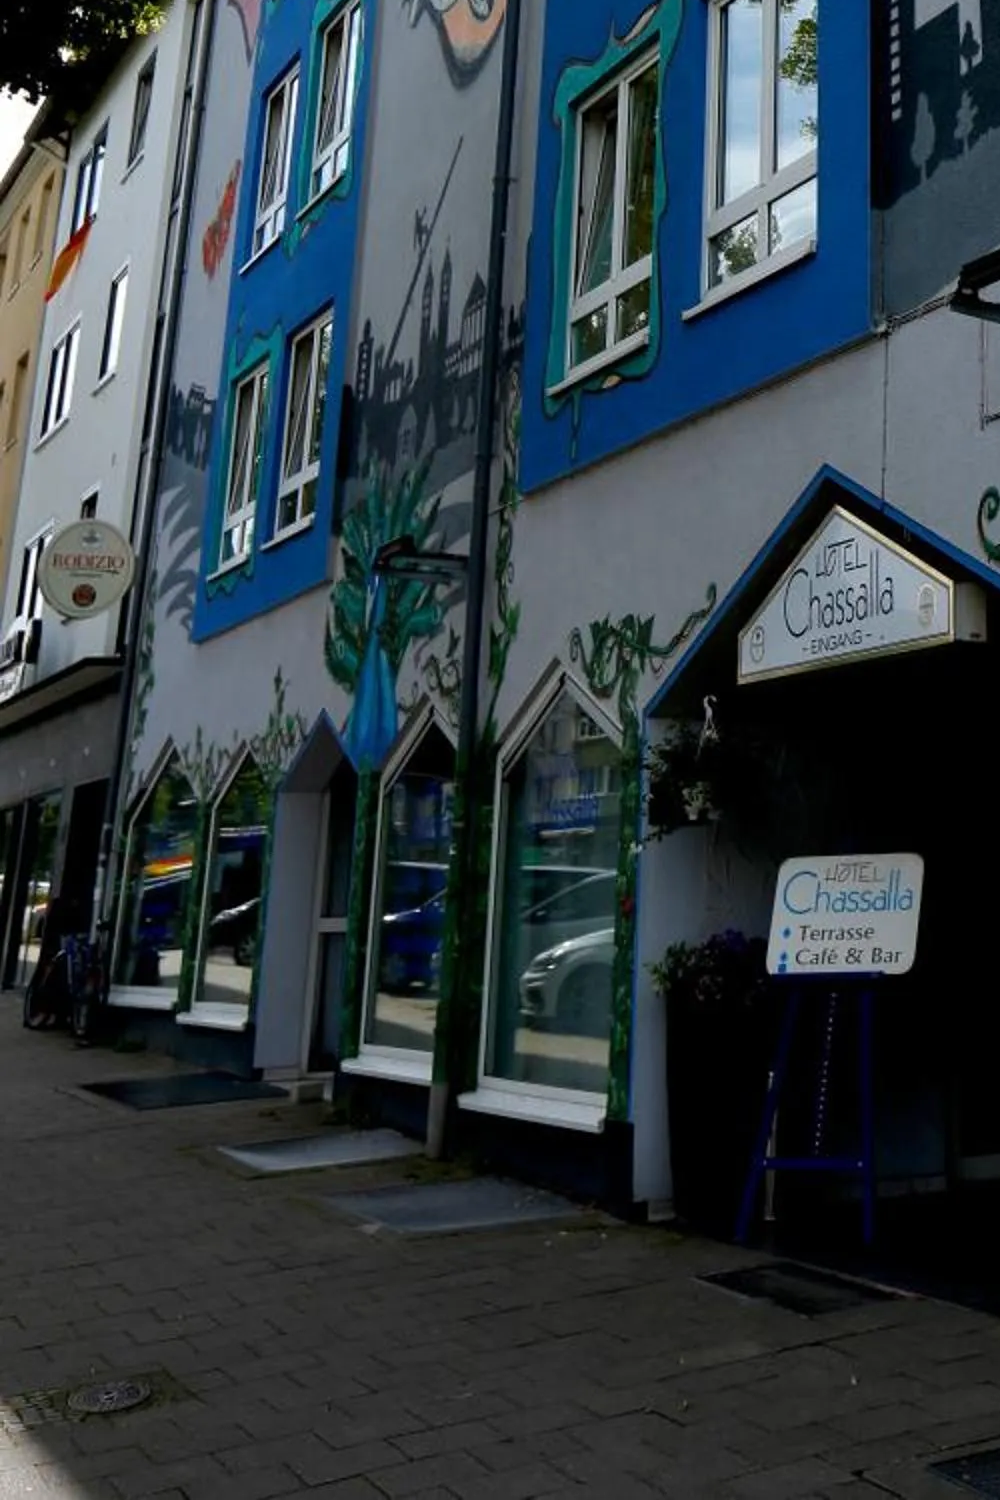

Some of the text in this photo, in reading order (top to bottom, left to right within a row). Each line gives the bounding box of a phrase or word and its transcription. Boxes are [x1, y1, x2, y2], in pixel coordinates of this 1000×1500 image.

[816, 538, 868, 577] HOTEL
[783, 549, 895, 638] Chassalla
[824, 862, 886, 883] HOTEL
[783, 869, 913, 915] Chassalla
[800, 925, 875, 942] Terrasse
[795, 948, 903, 966] Café & Bar
